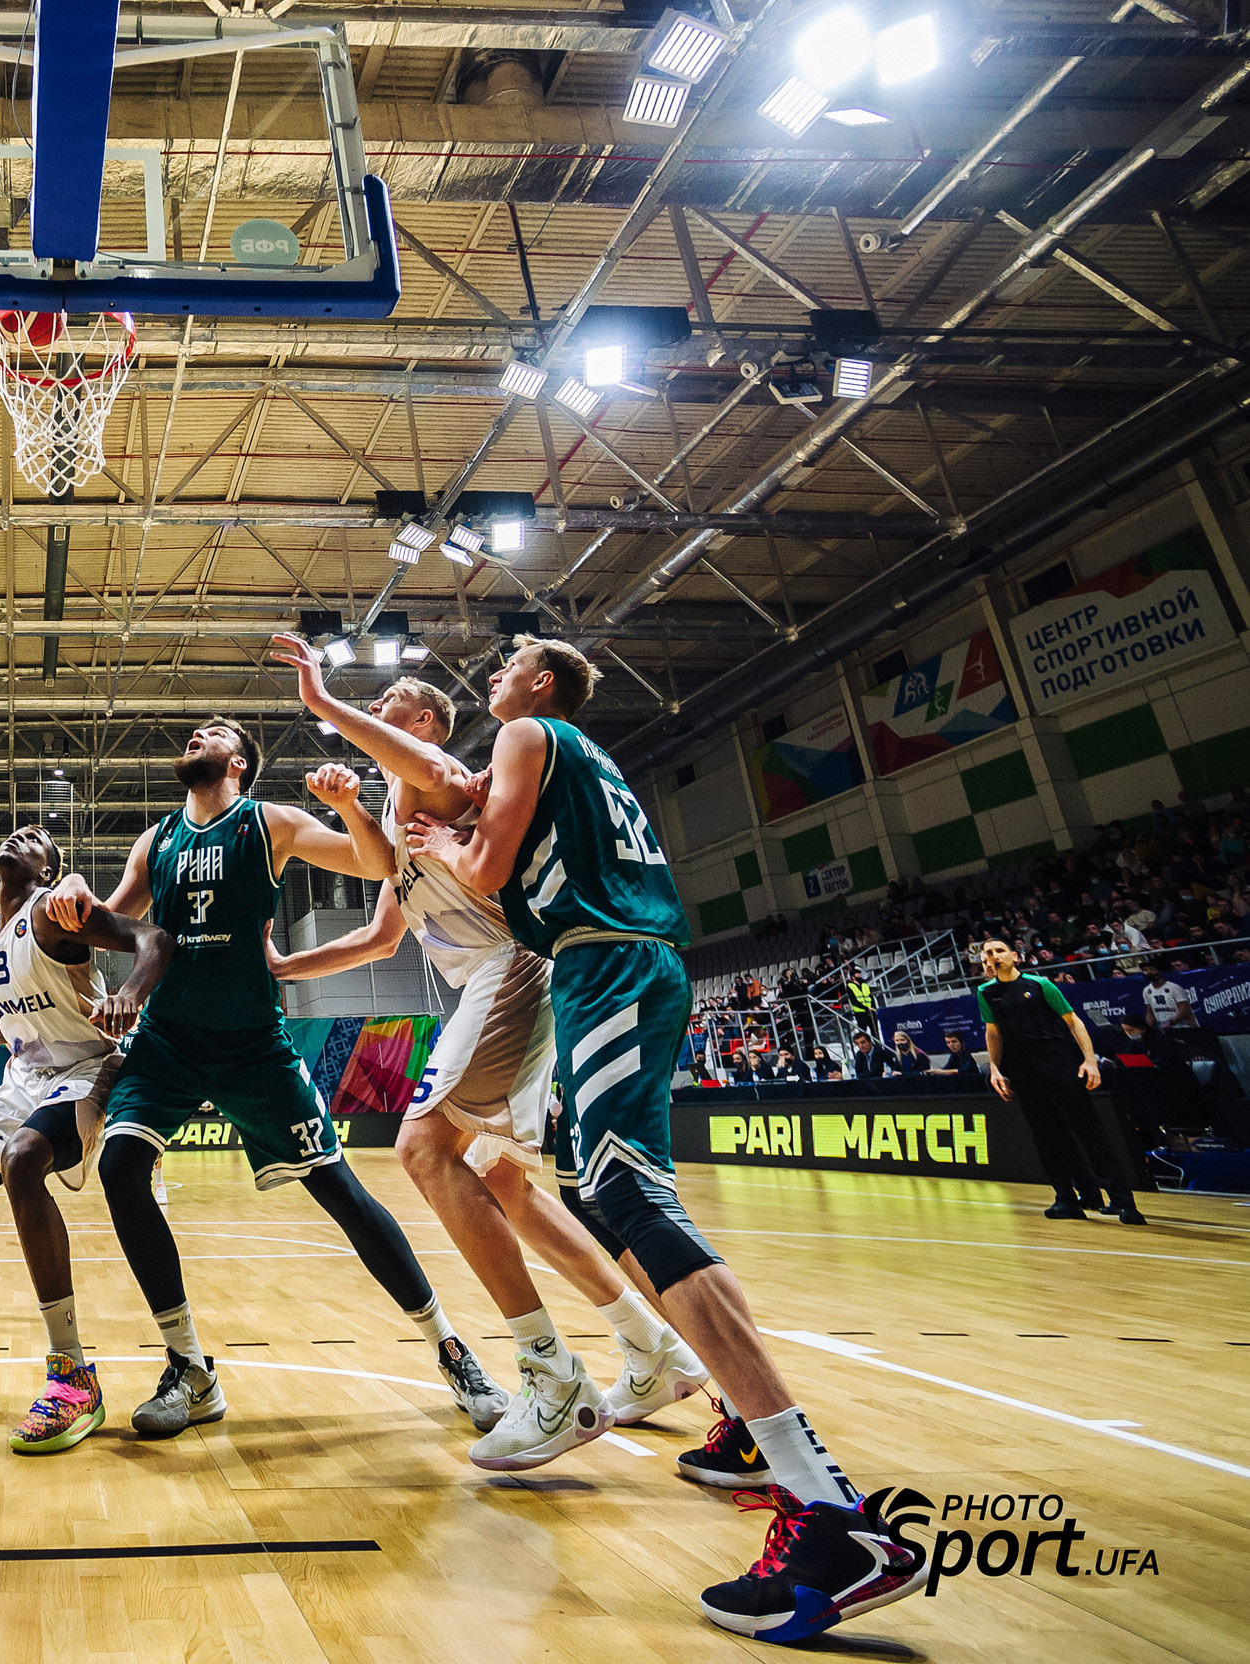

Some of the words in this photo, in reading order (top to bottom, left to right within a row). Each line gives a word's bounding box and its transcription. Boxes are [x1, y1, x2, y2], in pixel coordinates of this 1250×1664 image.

[1026, 604, 1098, 652] ЦЕНТР
[1033, 586, 1199, 674] СПОРТИВНОЙ
[1040, 618, 1206, 698] ПОДГОТОВКИ
[599, 778, 668, 865] 52
[176, 846, 224, 885] РУНА
[187, 889, 215, 924] 37
[186, 933, 232, 944] kraftway
[291, 1117, 324, 1157] 37
[709, 1115, 802, 1156] PARI
[811, 1114, 989, 1164] MATCH
